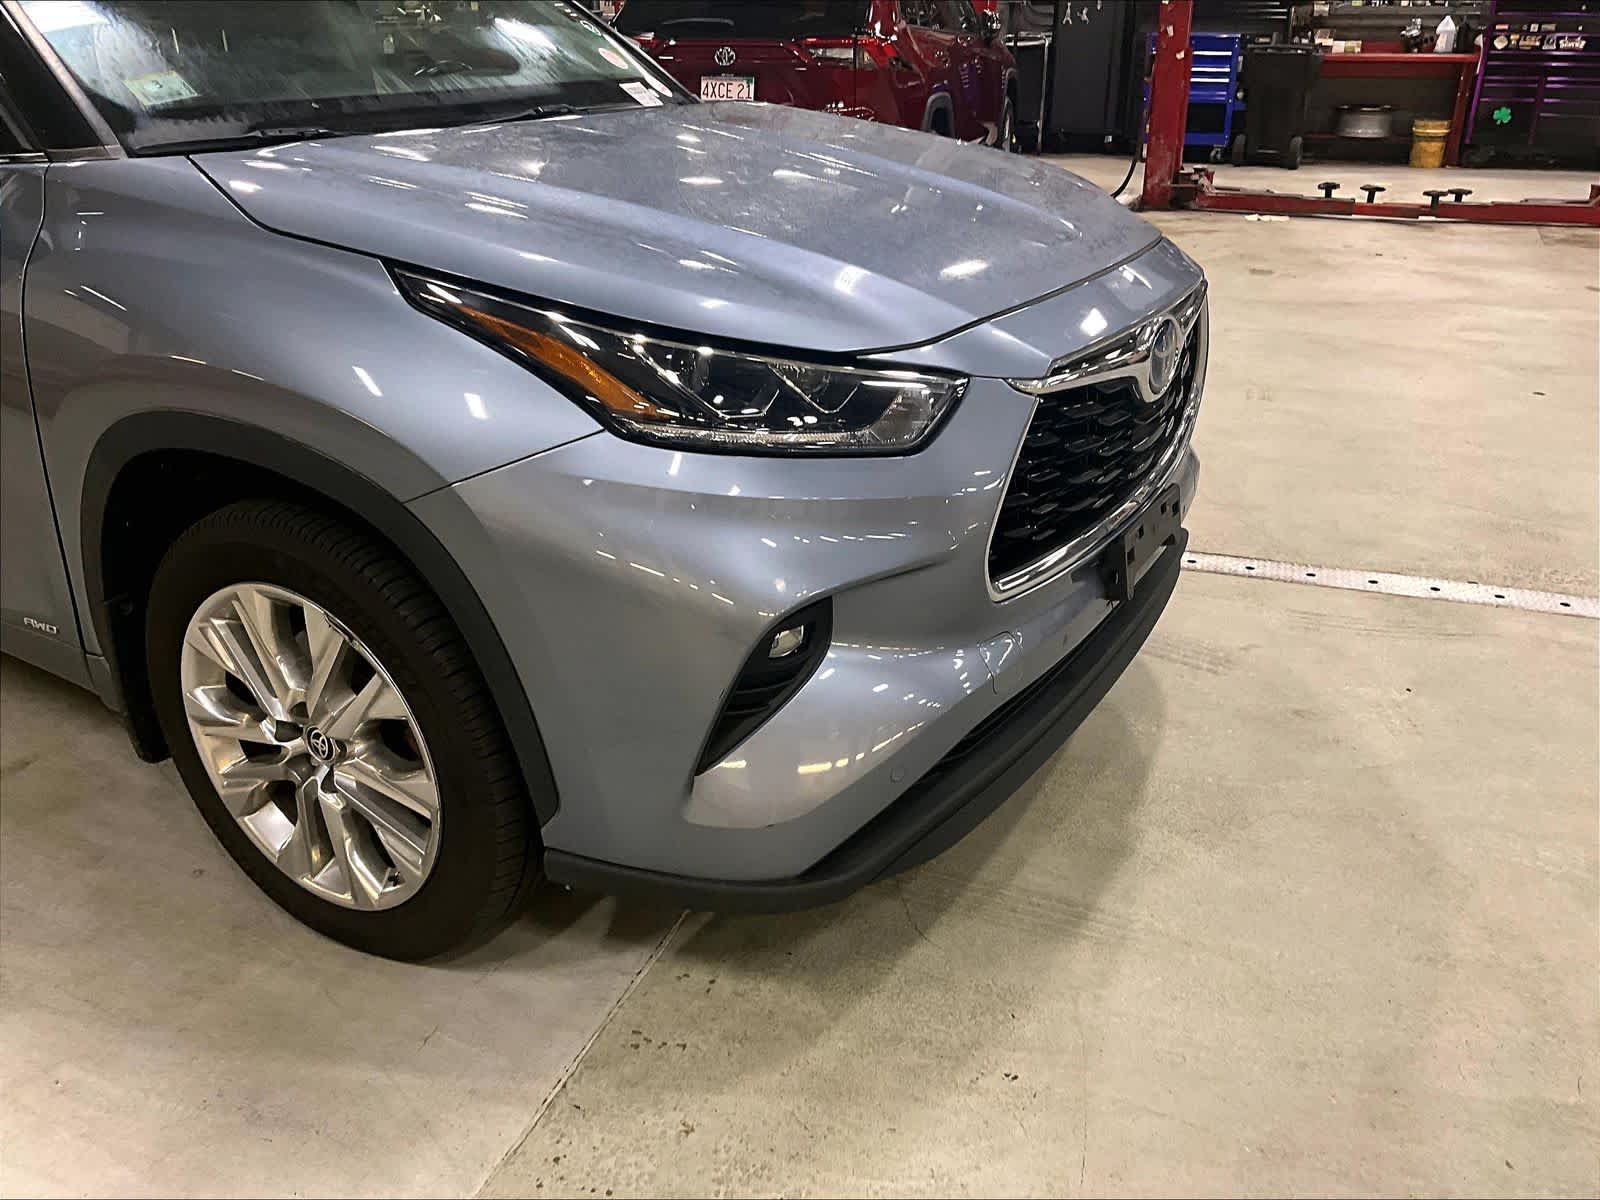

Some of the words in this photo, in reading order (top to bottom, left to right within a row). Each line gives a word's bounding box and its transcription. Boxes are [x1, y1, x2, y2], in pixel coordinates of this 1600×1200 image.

[702, 82, 734, 99] 4XCE
[737, 83, 752, 100] 21
[23, 617, 57, 635] AWD
